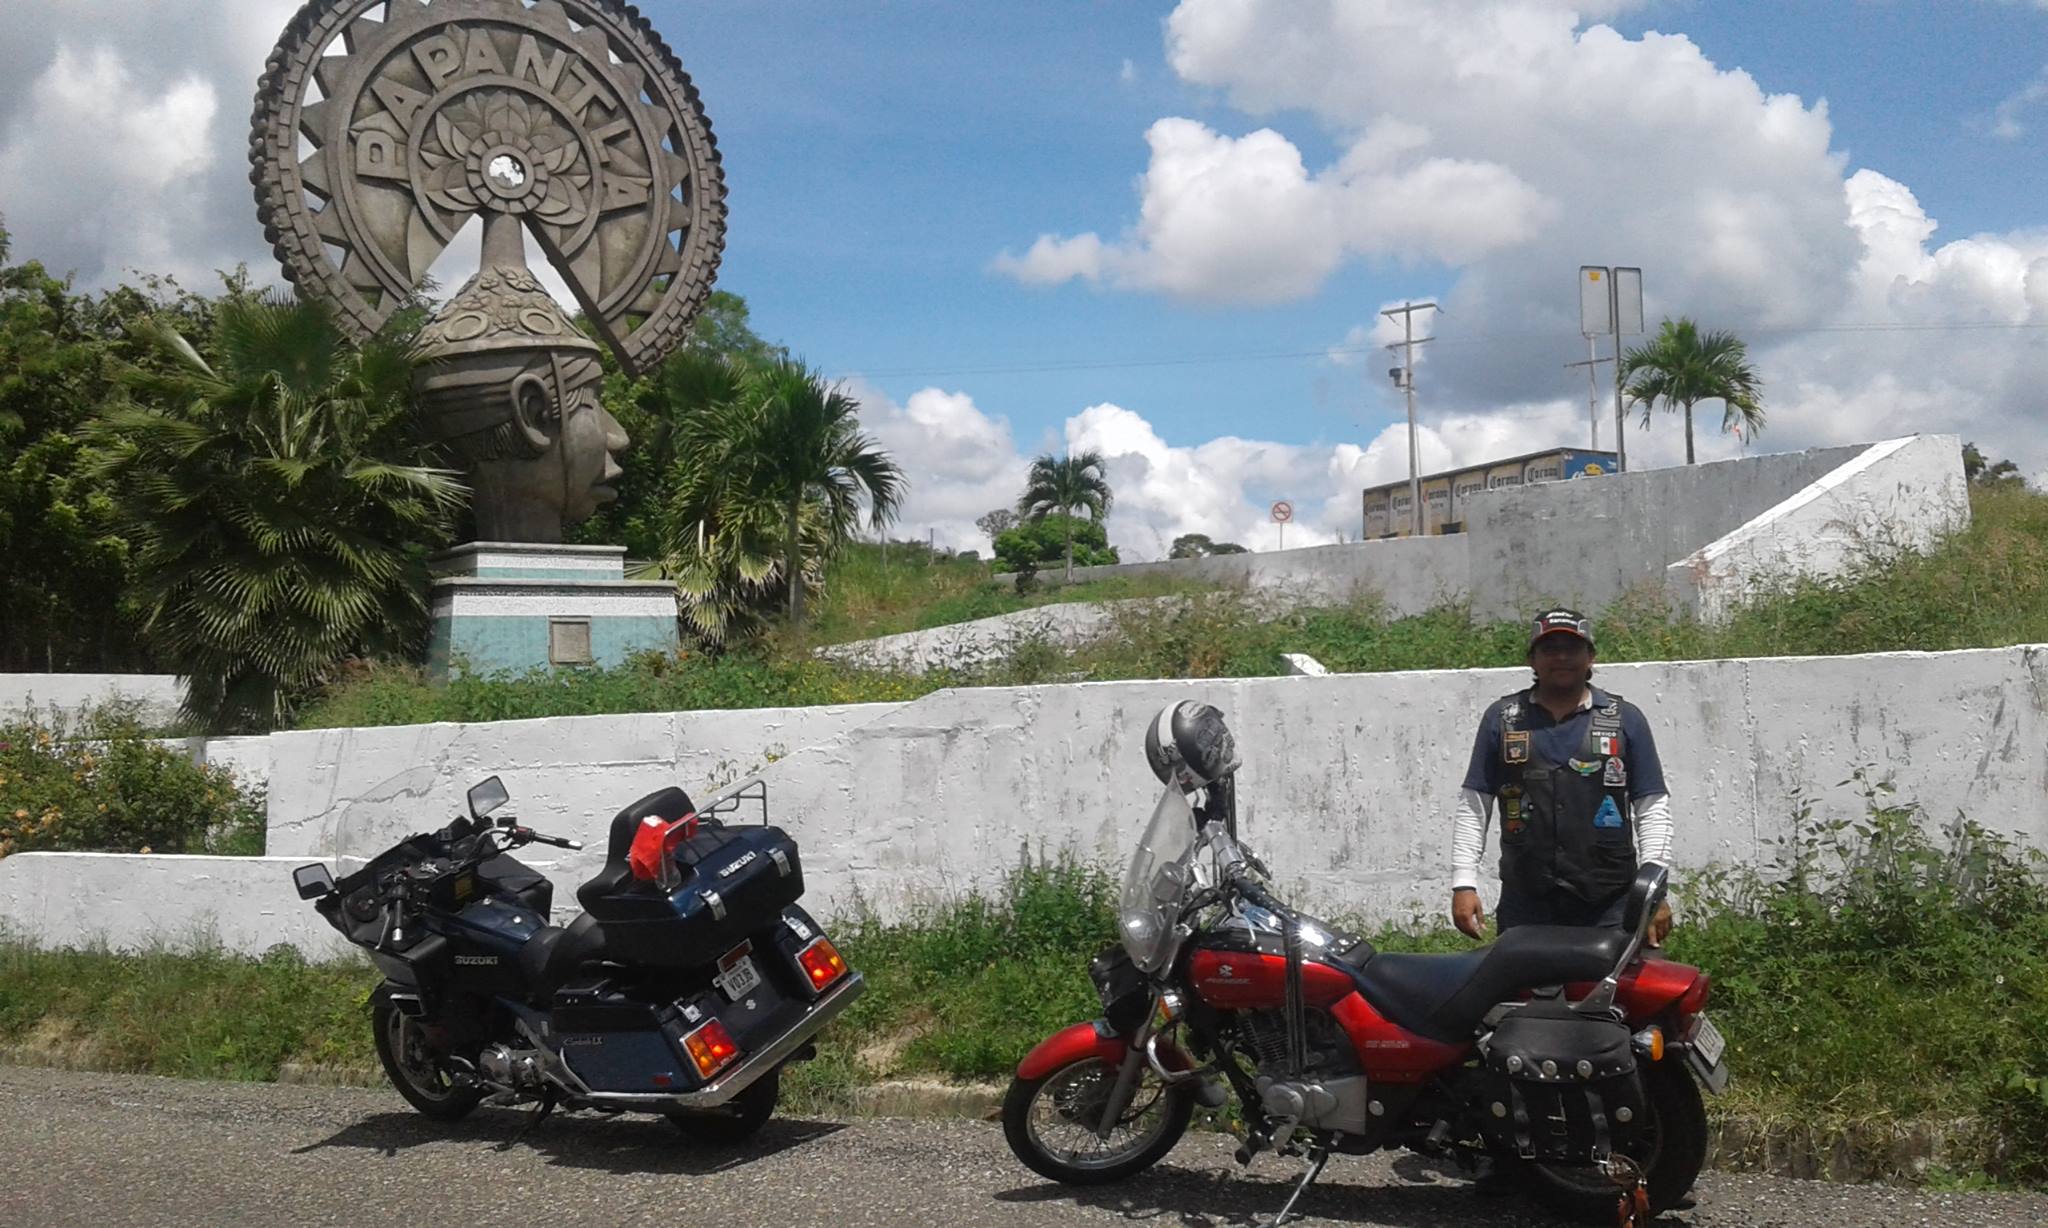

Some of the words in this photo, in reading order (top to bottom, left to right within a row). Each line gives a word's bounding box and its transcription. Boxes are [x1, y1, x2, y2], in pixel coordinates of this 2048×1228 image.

[355, 28, 651, 212] PAPANTLA
[719, 850, 757, 878] SUZUKI
[454, 955, 498, 965] SUZUKI
